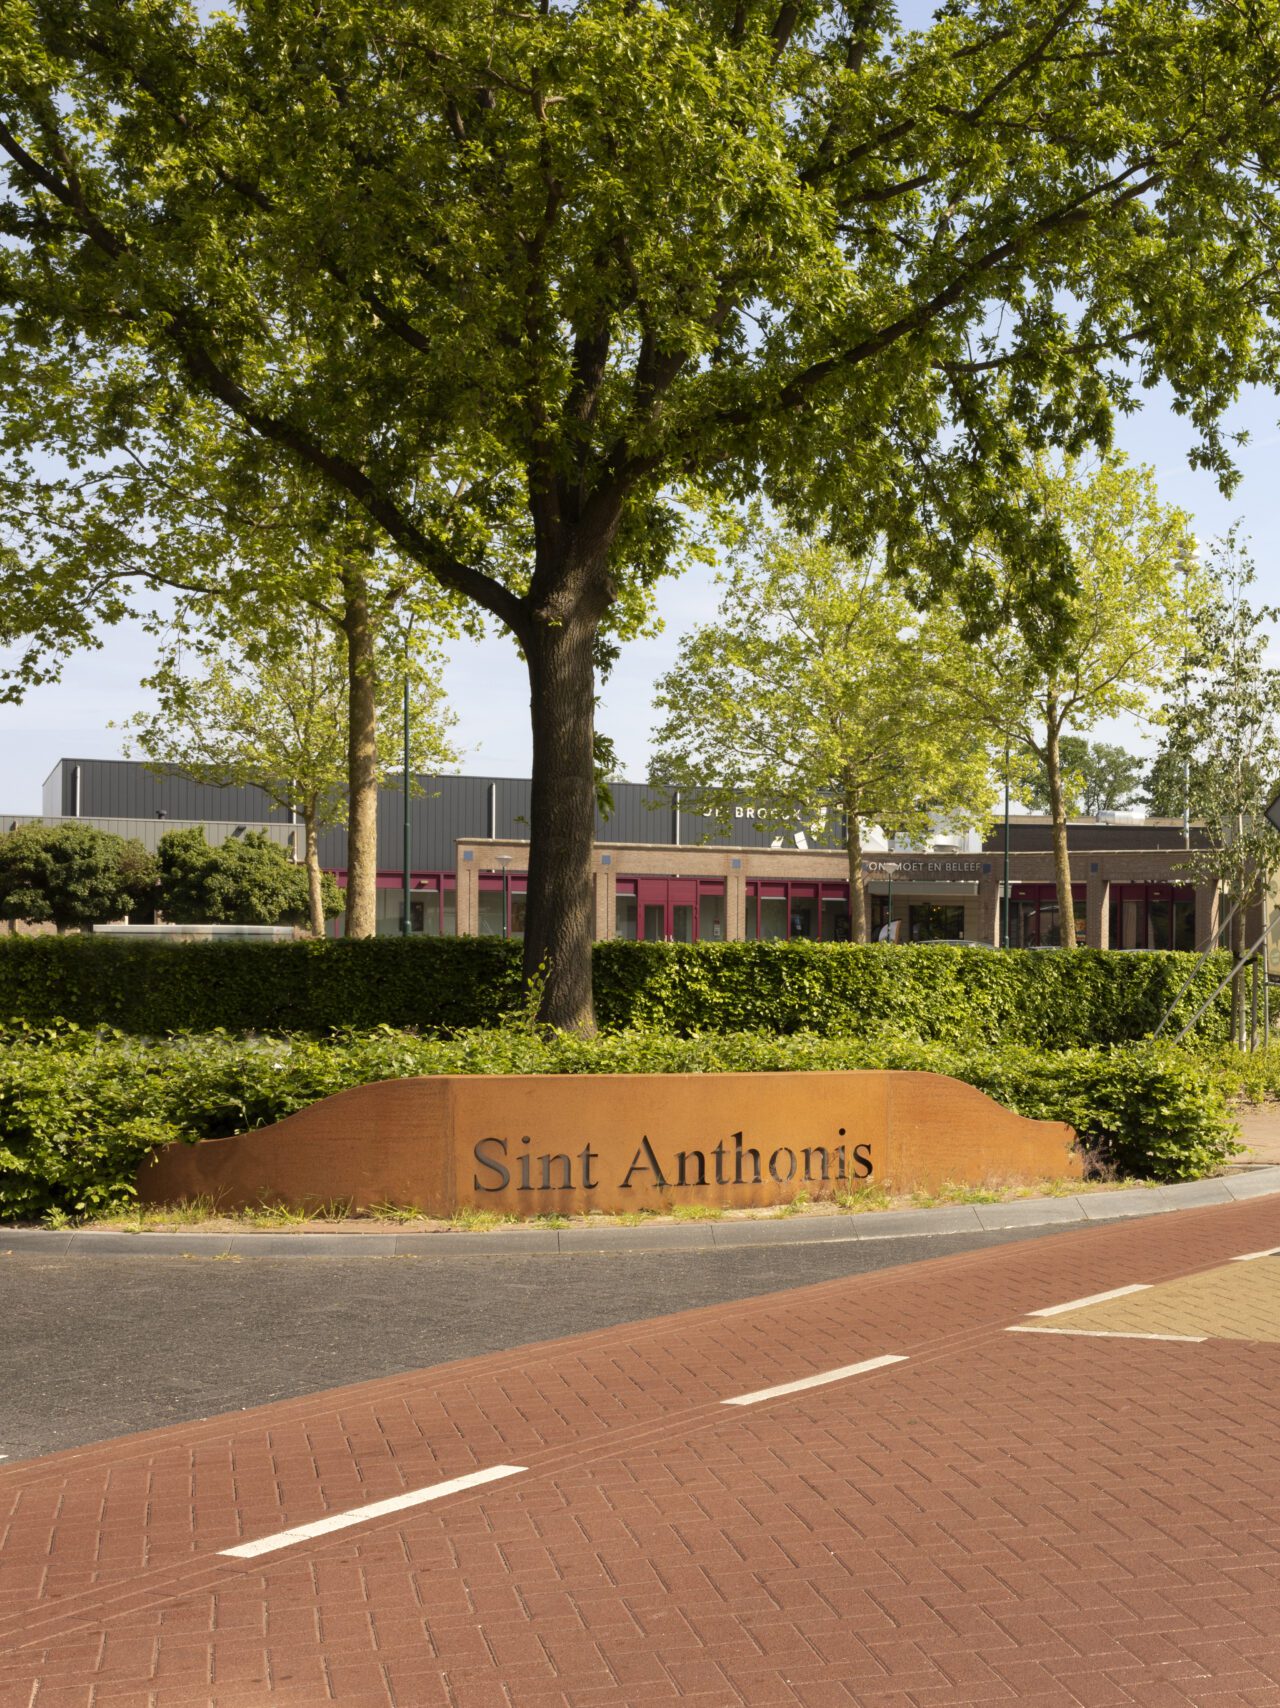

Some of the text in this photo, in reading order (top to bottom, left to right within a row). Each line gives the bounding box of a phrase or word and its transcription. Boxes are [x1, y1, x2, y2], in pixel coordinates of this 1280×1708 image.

[869, 861, 982, 872] ONMOET EN BELEEF
[473, 1127, 874, 1192] Sint Anthonis
